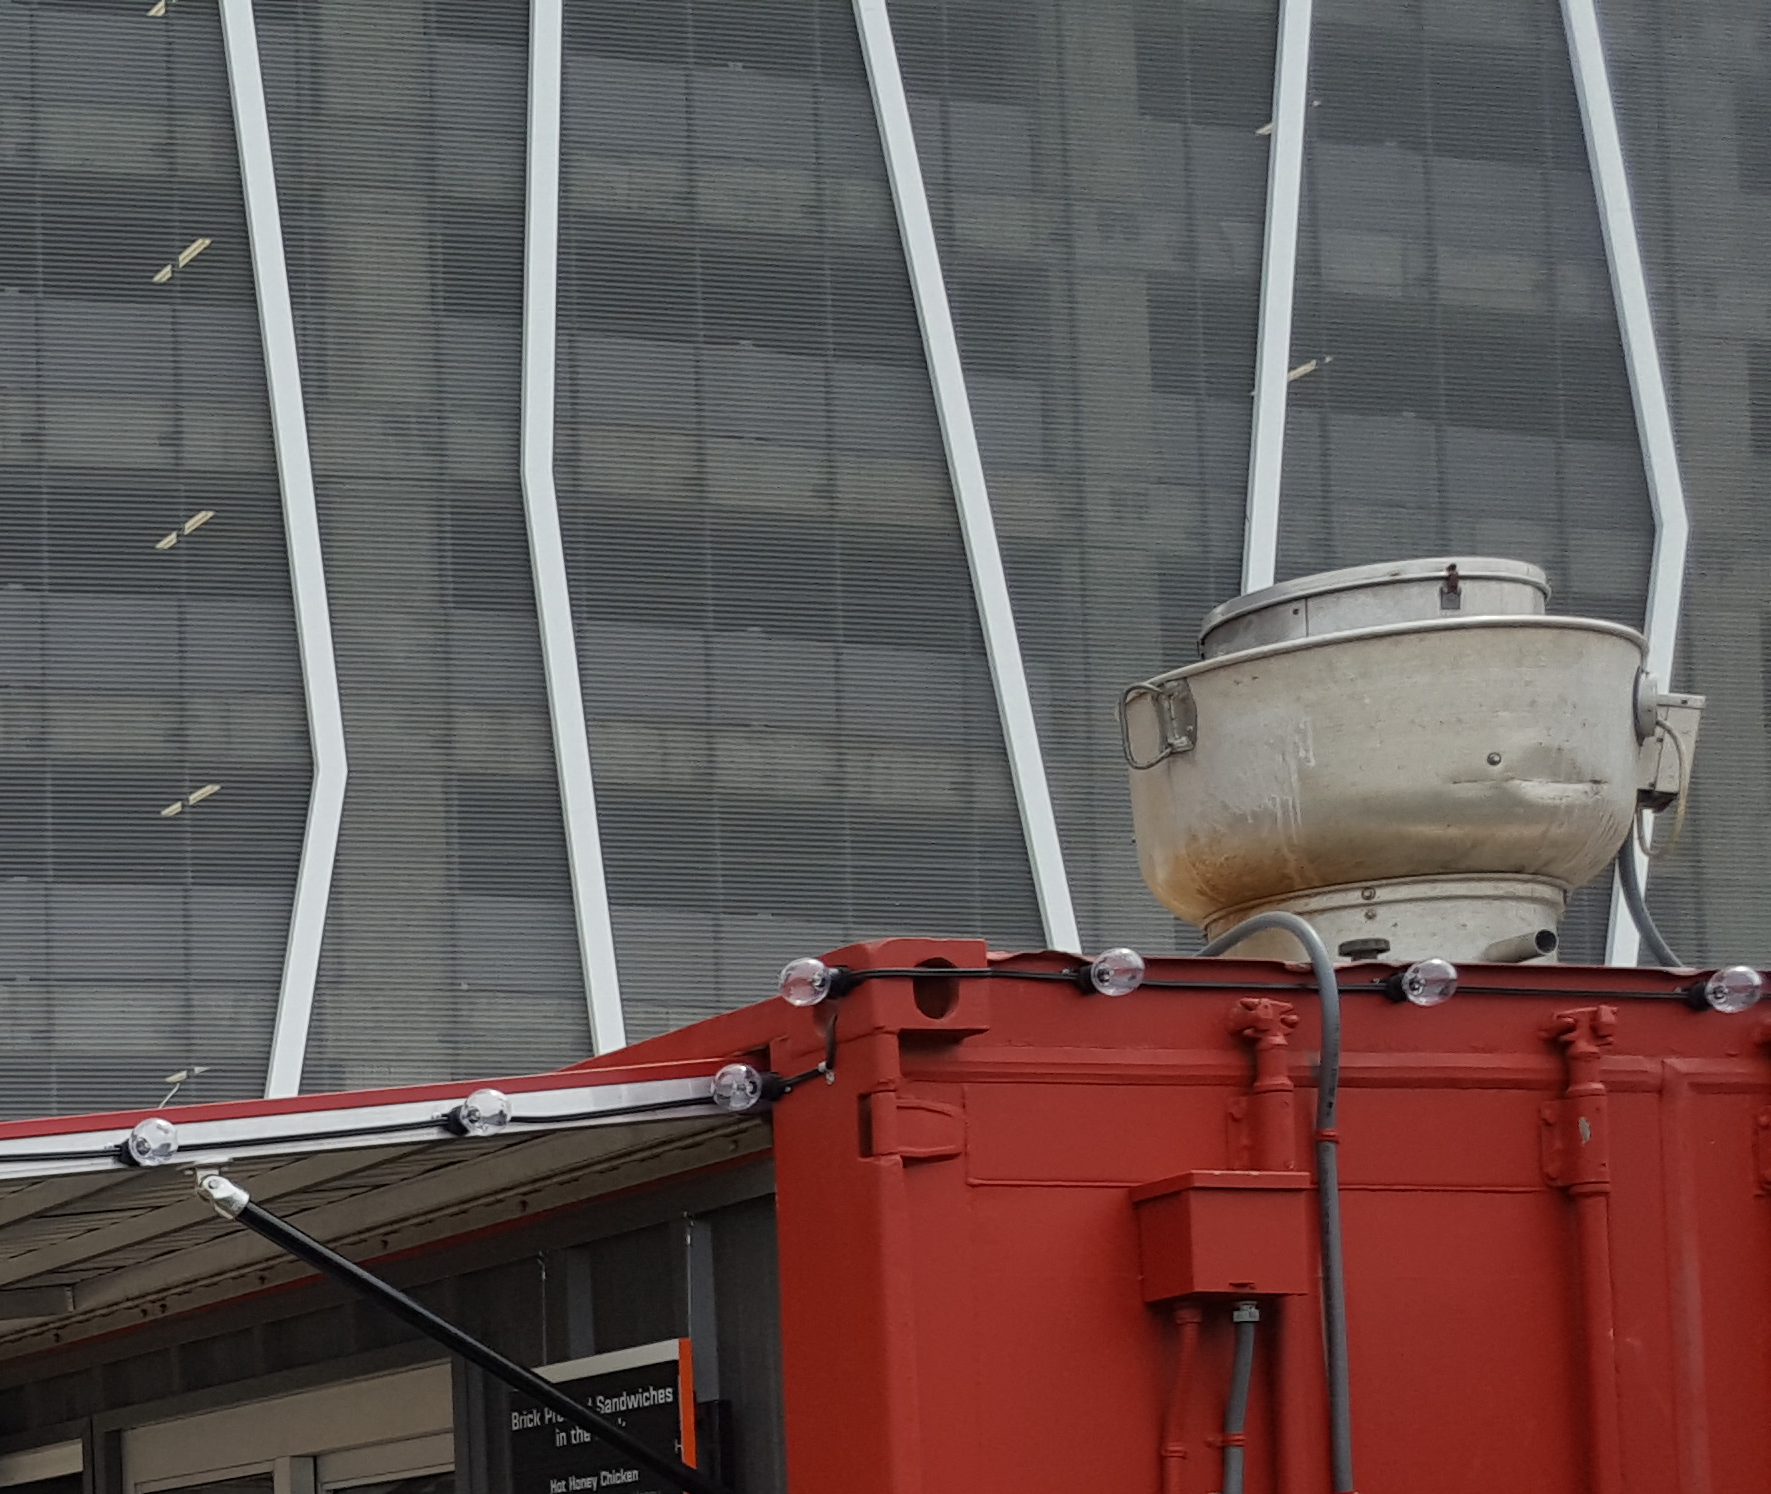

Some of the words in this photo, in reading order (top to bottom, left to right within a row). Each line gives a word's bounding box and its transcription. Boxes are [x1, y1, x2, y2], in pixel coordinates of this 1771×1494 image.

[512, 1408, 541, 1431] Brick
[596, 1386, 673, 1414] Sandwiches
[555, 1429, 567, 1447] in
[571, 1424, 591, 1443] the
[550, 1480, 566, 1494] Hot
[569, 1476, 597, 1491] Honey
[600, 1469, 639, 1486] Chicken
